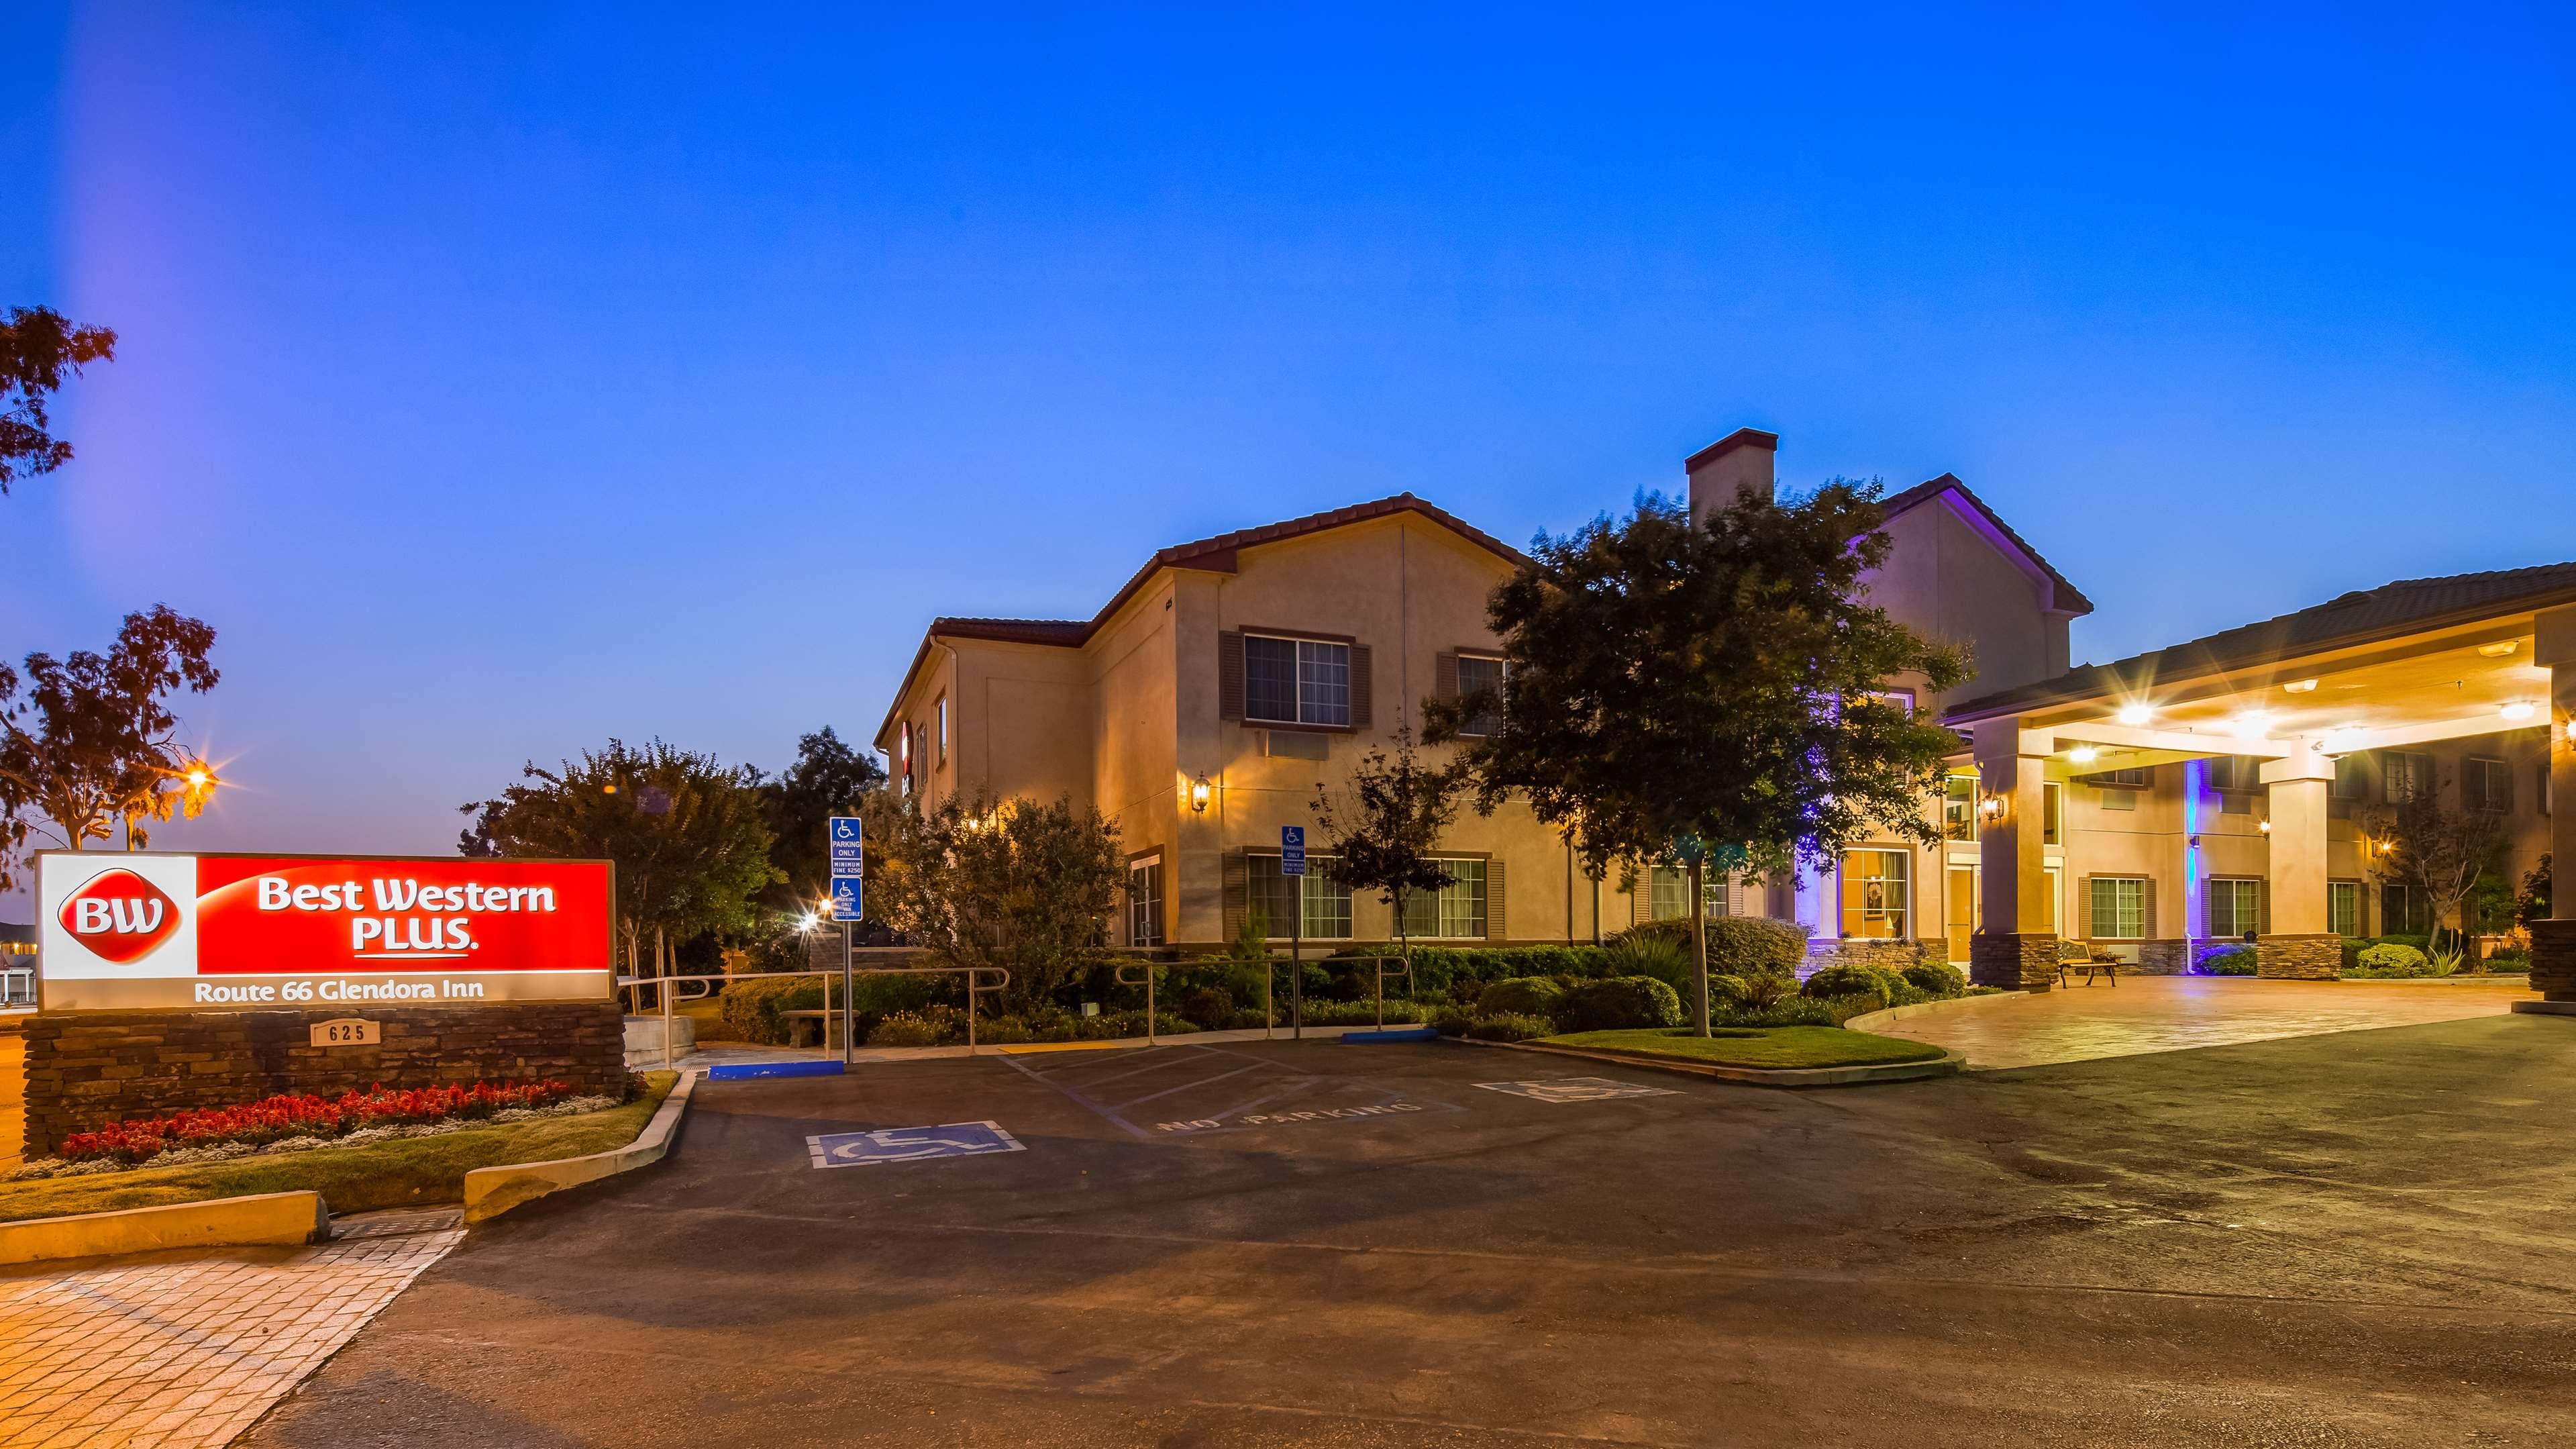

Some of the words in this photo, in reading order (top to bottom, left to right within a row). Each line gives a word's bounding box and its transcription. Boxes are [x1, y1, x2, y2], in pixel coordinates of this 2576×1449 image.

[258, 877, 365, 911] Best
[372, 878, 557, 912] Western
[76, 898, 164, 934] BW
[195, 982, 275, 1003] Route
[282, 981, 313, 1001] 66
[319, 979, 436, 1000] Glendora
[443, 979, 484, 998] Inn
[329, 1025, 364, 1042] 625
[1155, 1119, 1221, 1132] NO
[1239, 1103, 1423, 1124] PARKING
